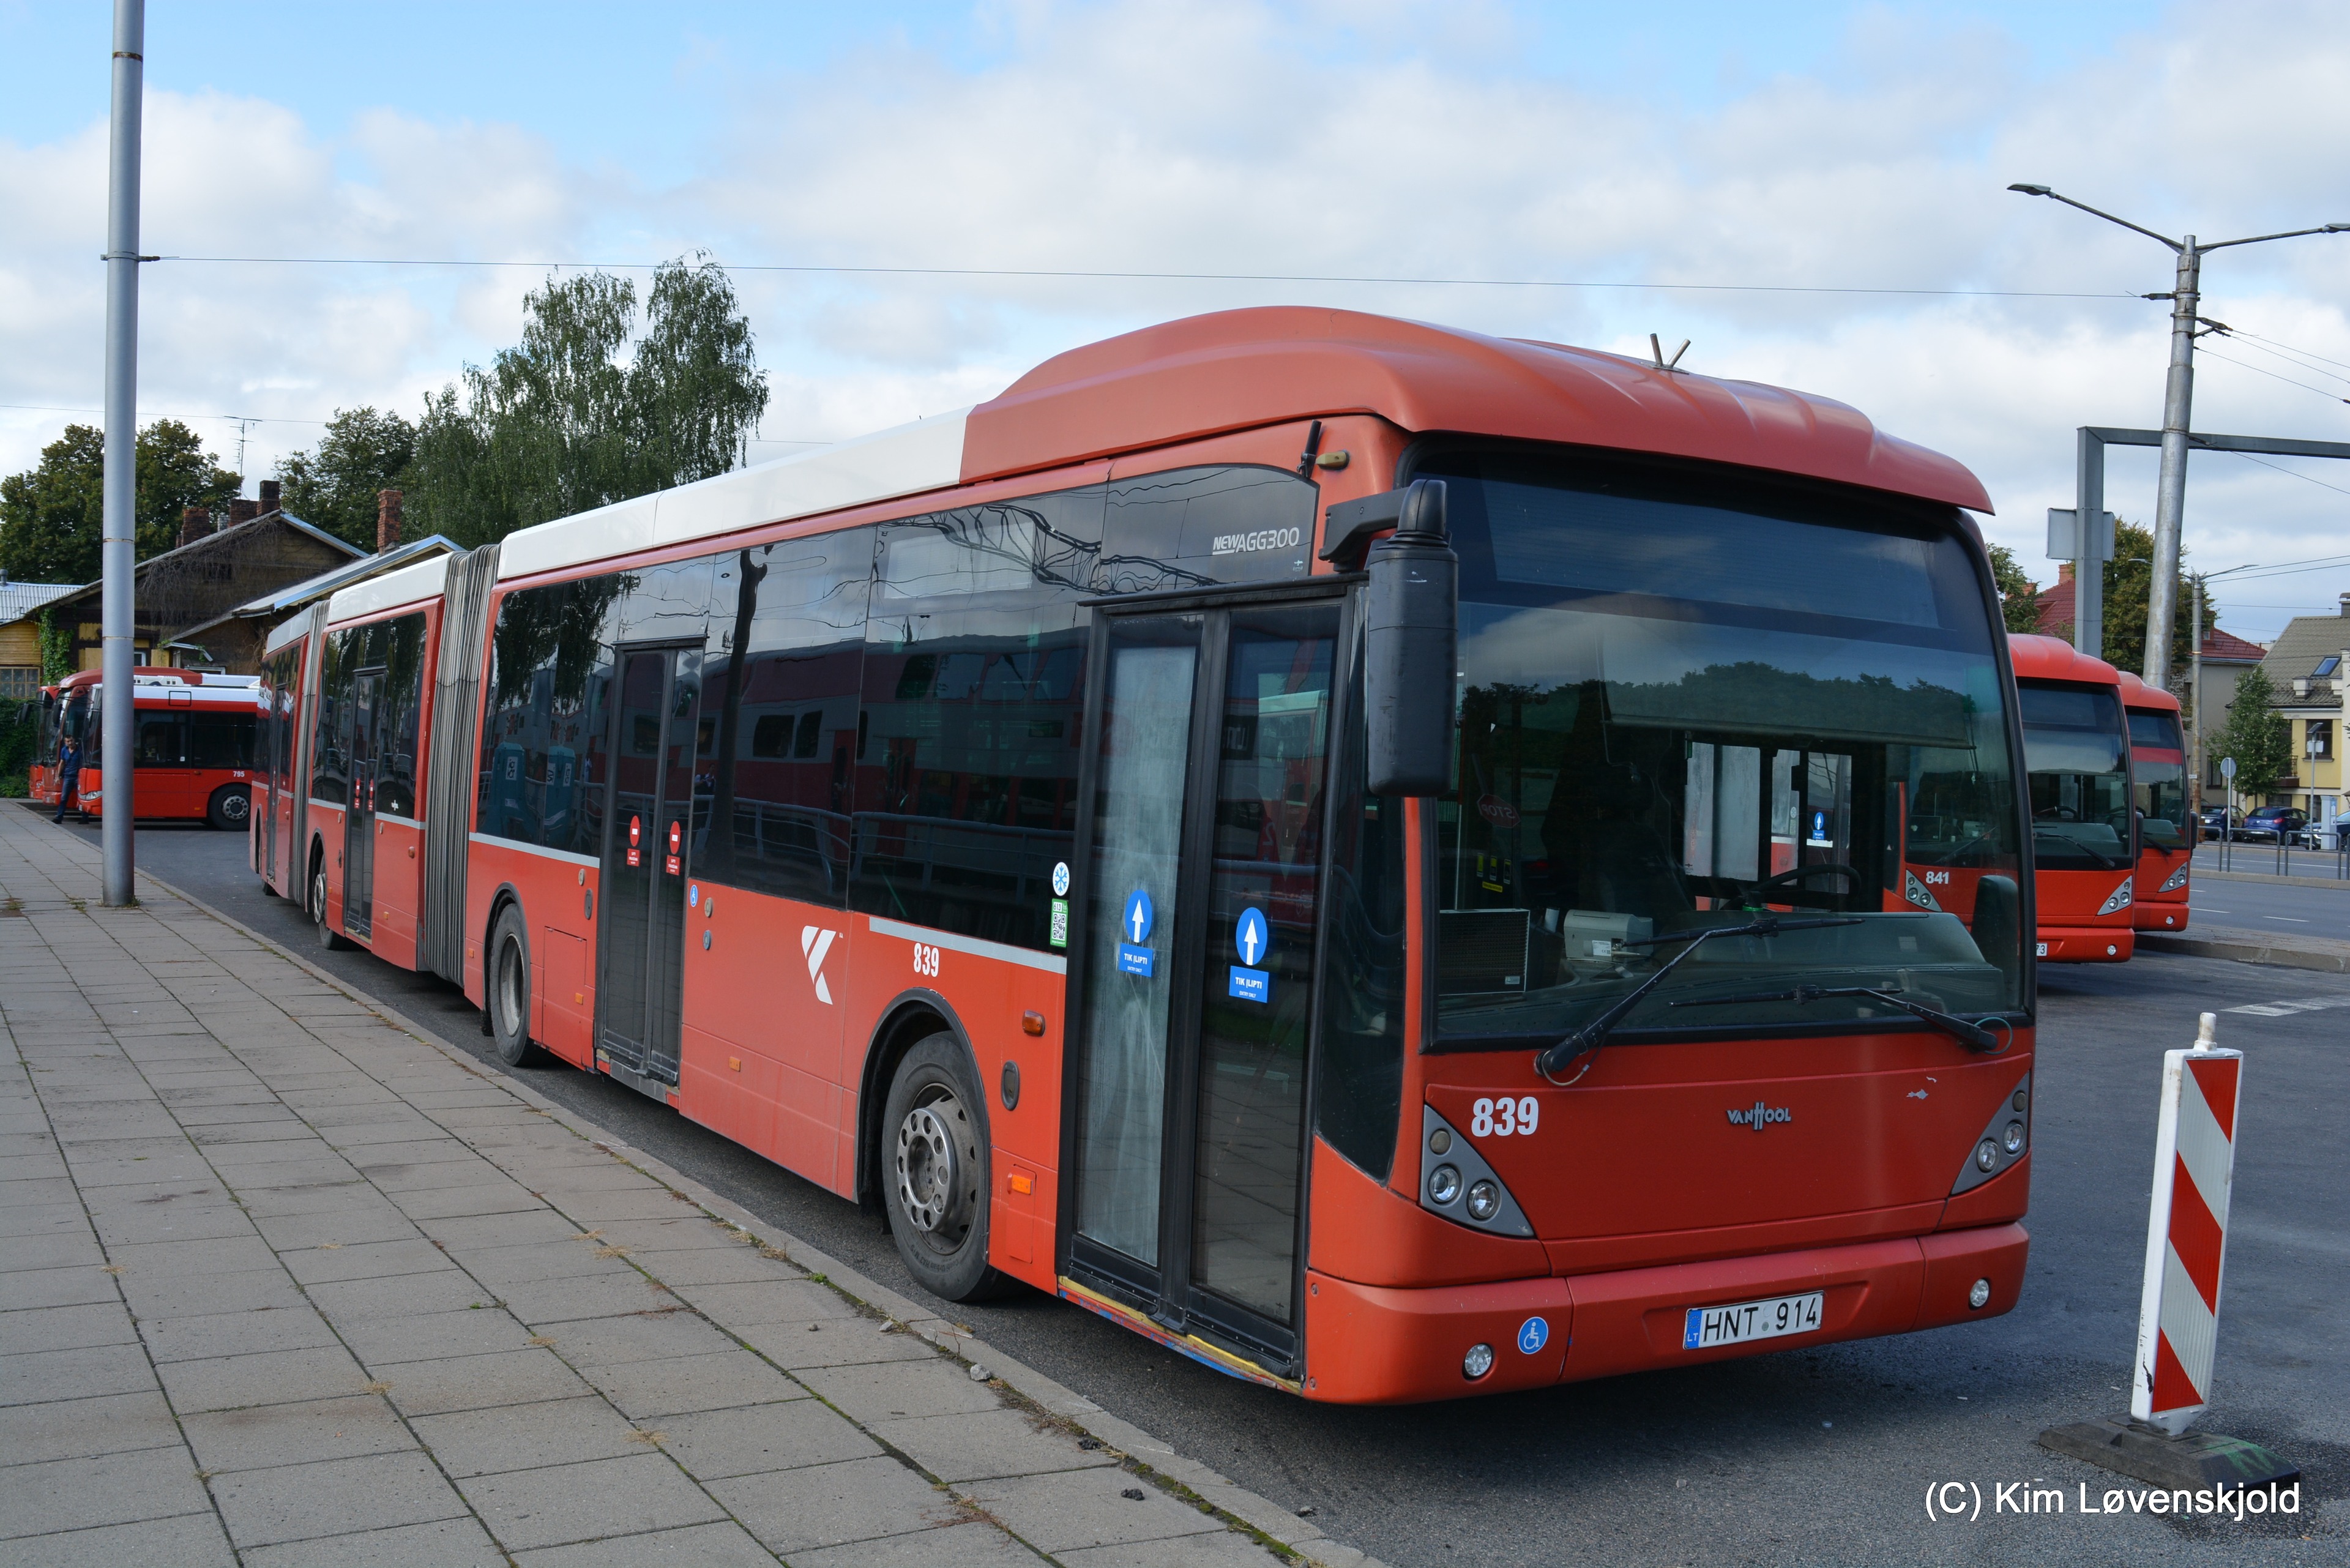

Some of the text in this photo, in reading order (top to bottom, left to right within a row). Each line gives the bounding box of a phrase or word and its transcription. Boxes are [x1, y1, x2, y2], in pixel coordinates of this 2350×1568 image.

[1925, 871, 1950, 884] 841
[1053, 902, 1062, 912] 613
[913, 943, 940, 977] 839
[1124, 953, 1133, 962] TIK
[1235, 976, 1245, 986] TIK
[1471, 1096, 1539, 1138] 839
[1687, 1297, 1817, 1342] LT HNT 914
